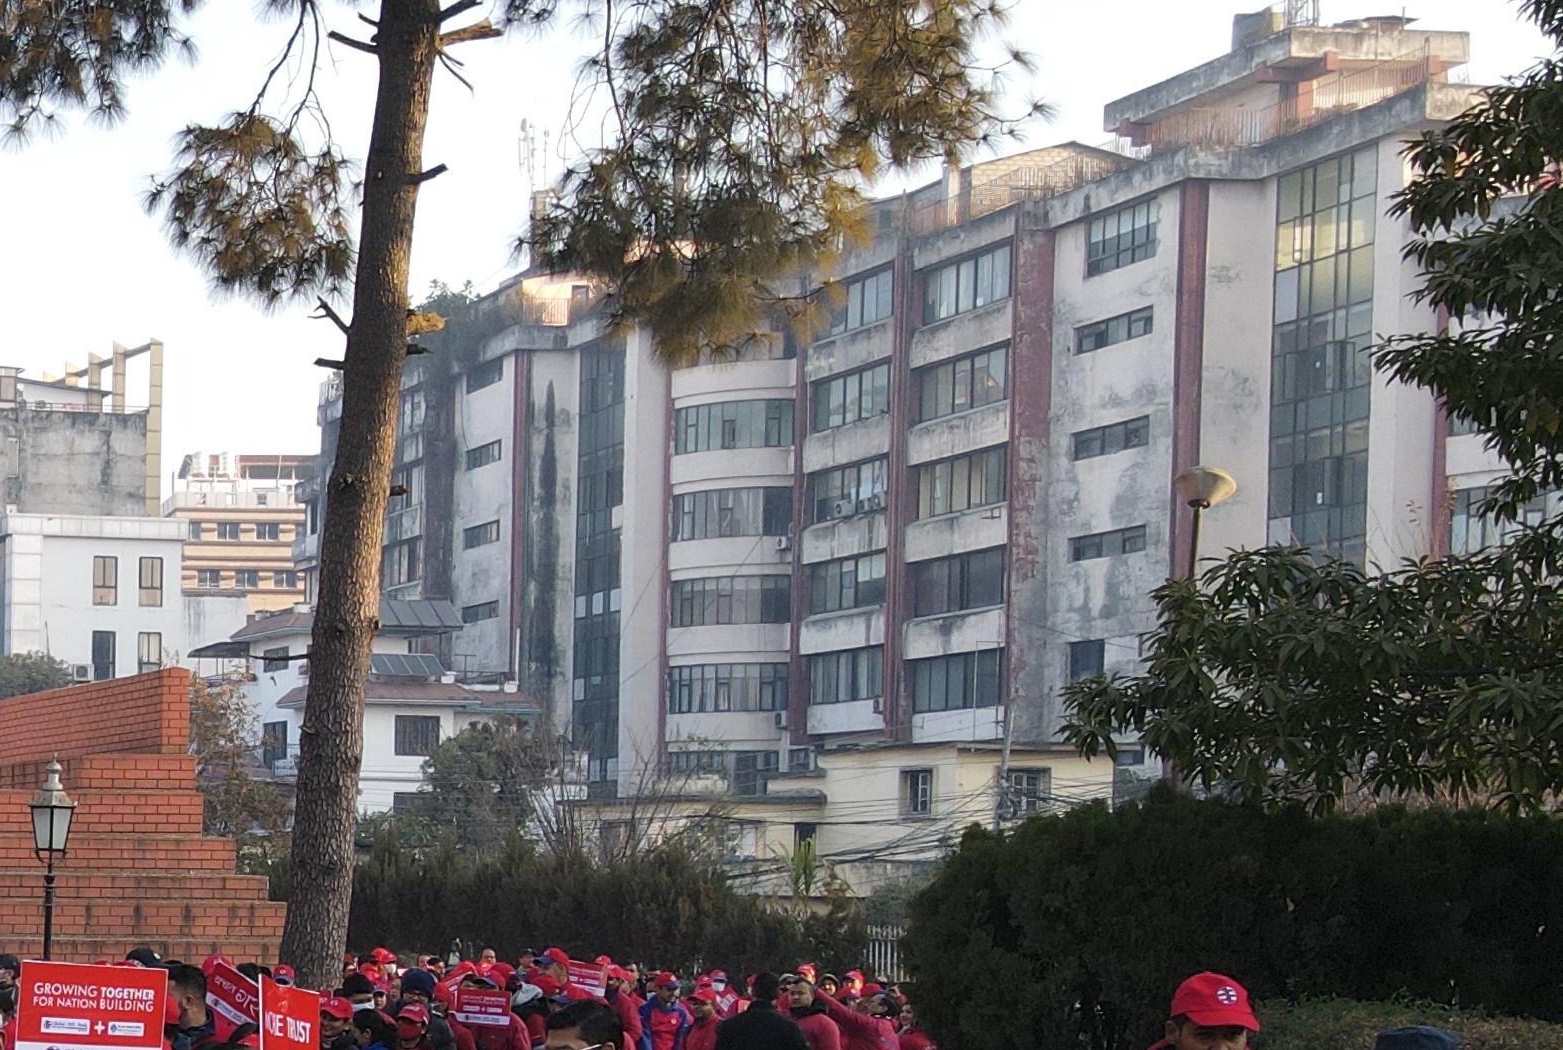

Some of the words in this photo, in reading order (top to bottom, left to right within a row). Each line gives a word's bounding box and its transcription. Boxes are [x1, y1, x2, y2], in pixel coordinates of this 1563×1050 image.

[34, 982, 98, 998] GROWING
[100, 986, 155, 1000] TOGETHER
[33, 996, 54, 1008] FOR
[56, 998, 97, 1010] NATION
[99, 999, 154, 1013] BUILDING
[286, 1016, 312, 1044] TRUST
